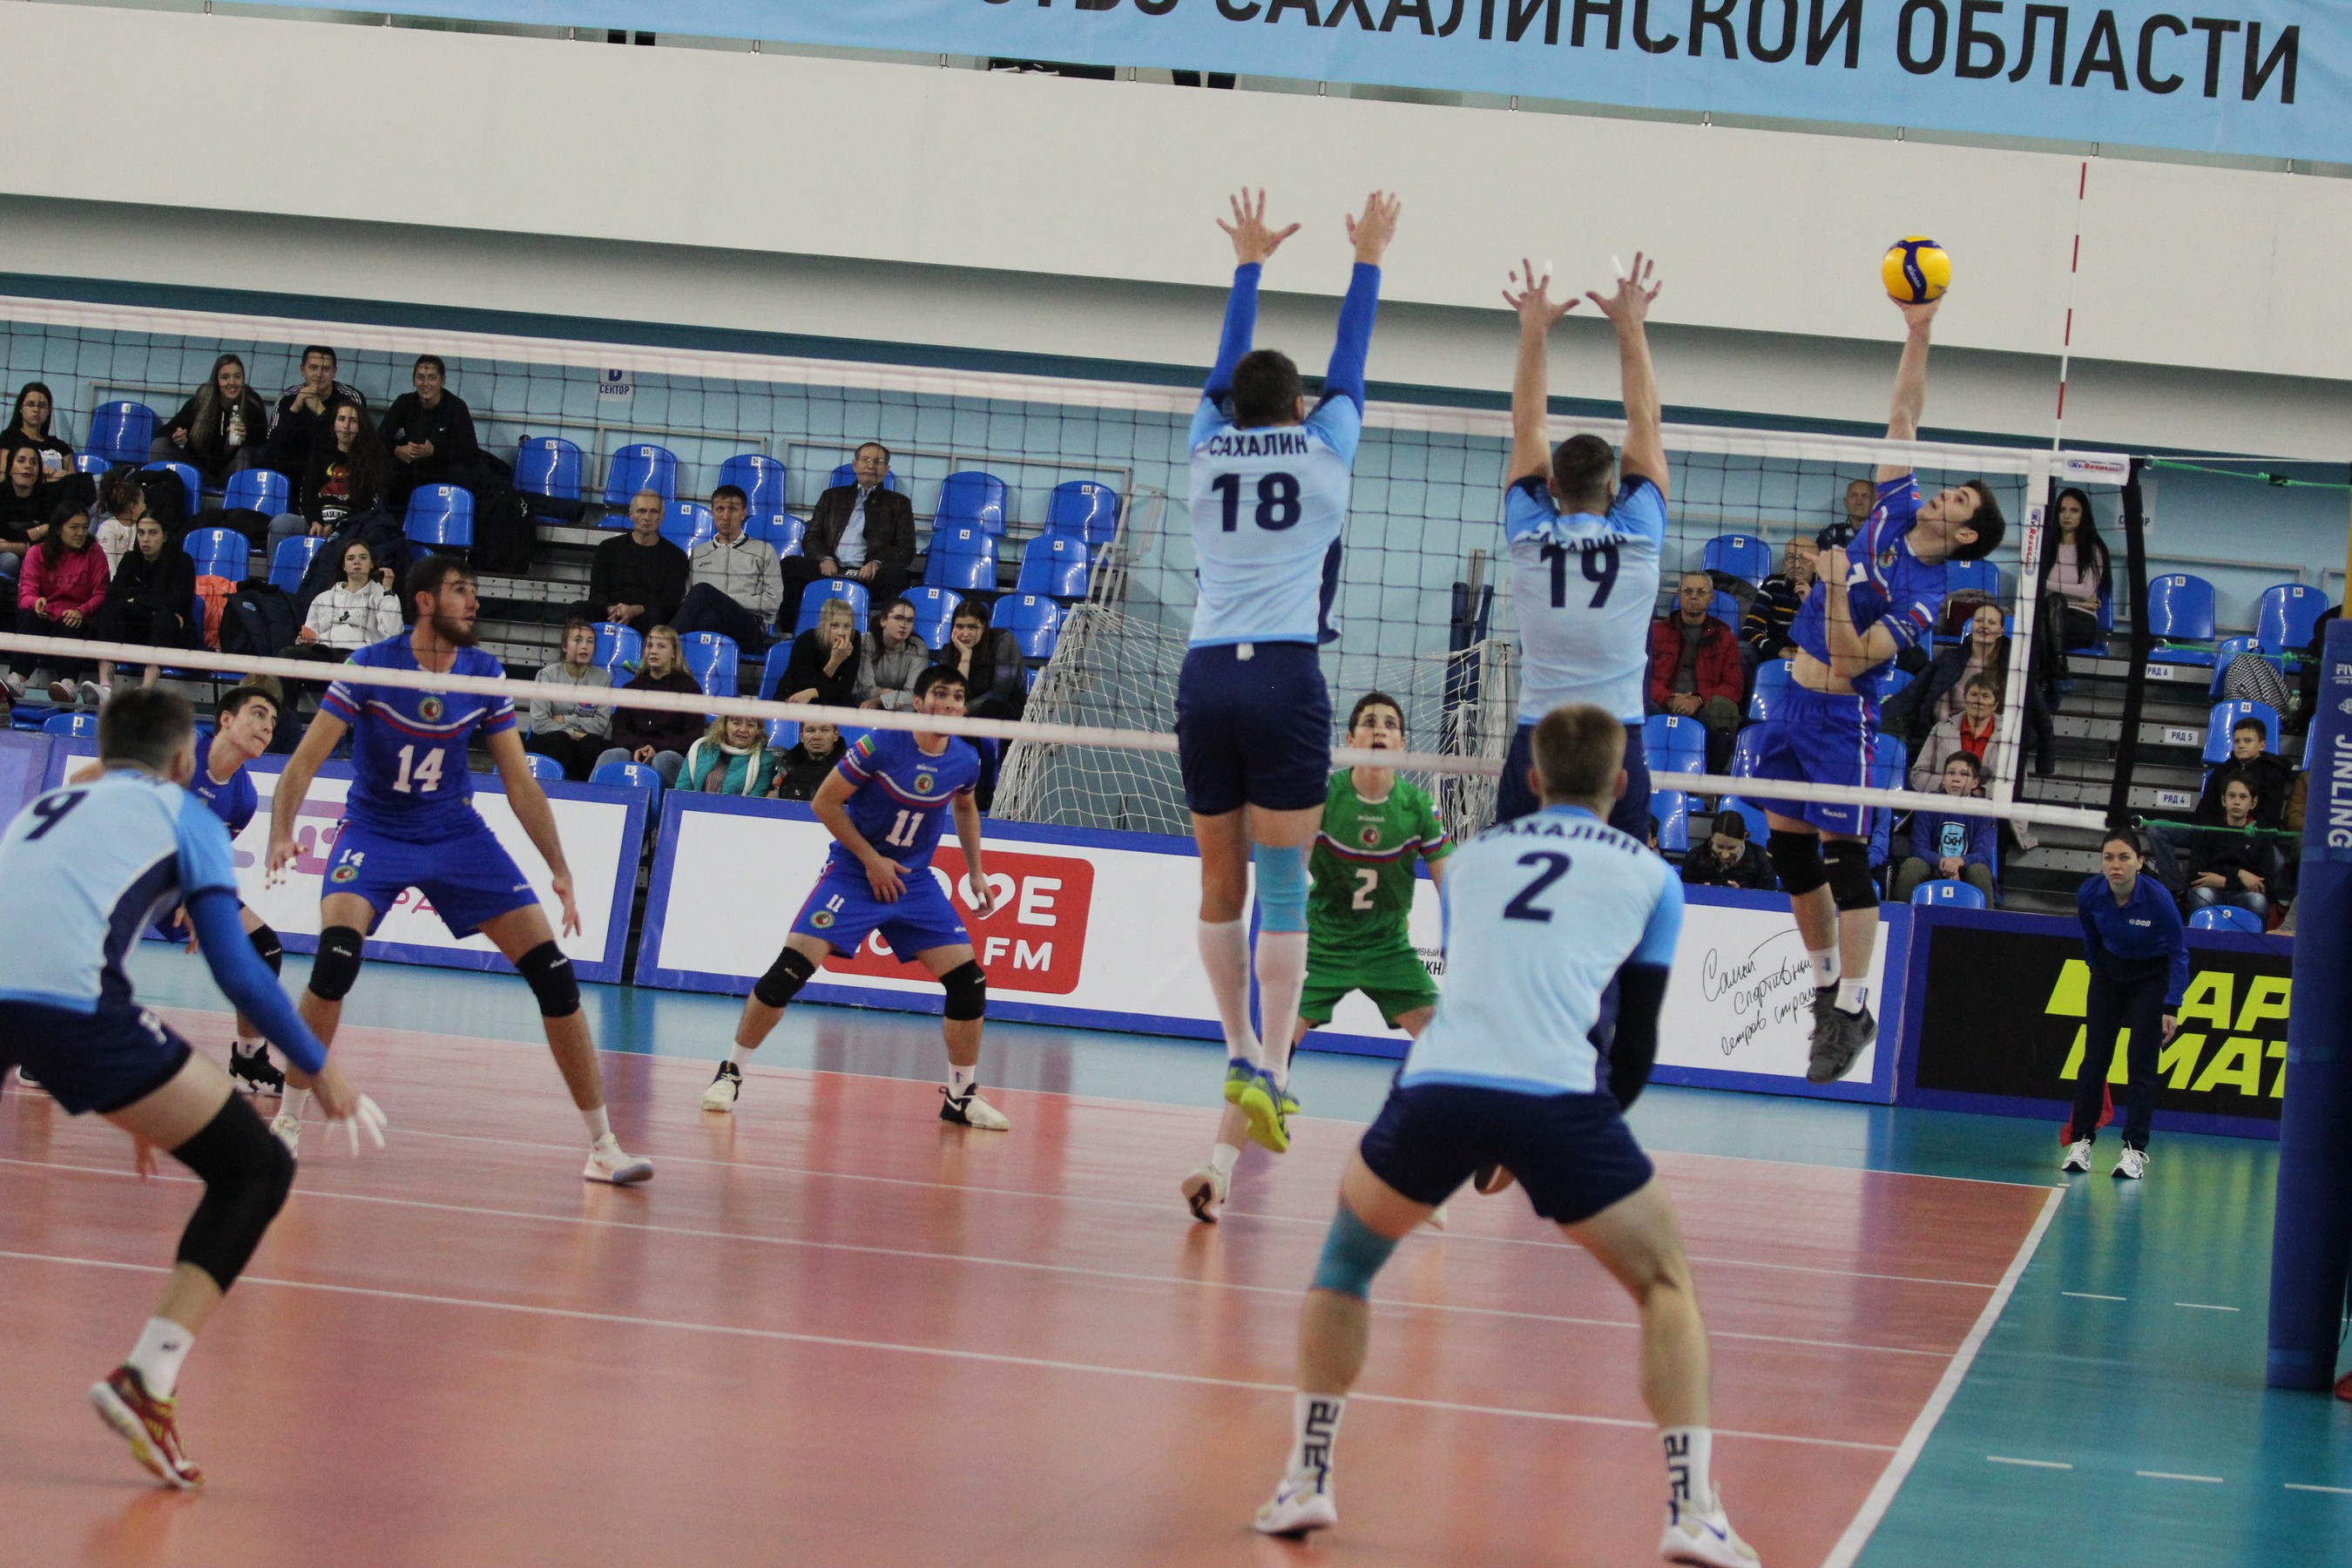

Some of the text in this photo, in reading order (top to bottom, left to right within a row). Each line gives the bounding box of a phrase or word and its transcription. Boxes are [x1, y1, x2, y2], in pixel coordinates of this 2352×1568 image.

[1896, 0, 2301, 105] ОБЛАСТИ
[599, 384, 630, 395] СЕКТОР
[1209, 433, 1308, 456] САХАЛИН
[1212, 472, 1302, 531] 18
[1540, 544, 1620, 608] 19
[2147, 666, 2161, 676] РЯД
[2172, 732, 2193, 741] РЯД 5
[393, 745, 446, 794] 14
[2164, 794, 2186, 804] РЯД 4
[2328, 734, 2352, 848] JINLING
[24, 790, 90, 841] 9
[885, 809, 924, 848] 11
[1478, 820, 1640, 855] АХАЛИН
[339, 848, 365, 867] 14
[826, 894, 845, 913] 11
[1352, 868, 1378, 909] 2
[1504, 850, 1572, 923] 2
[983, 936, 1052, 971] FM
